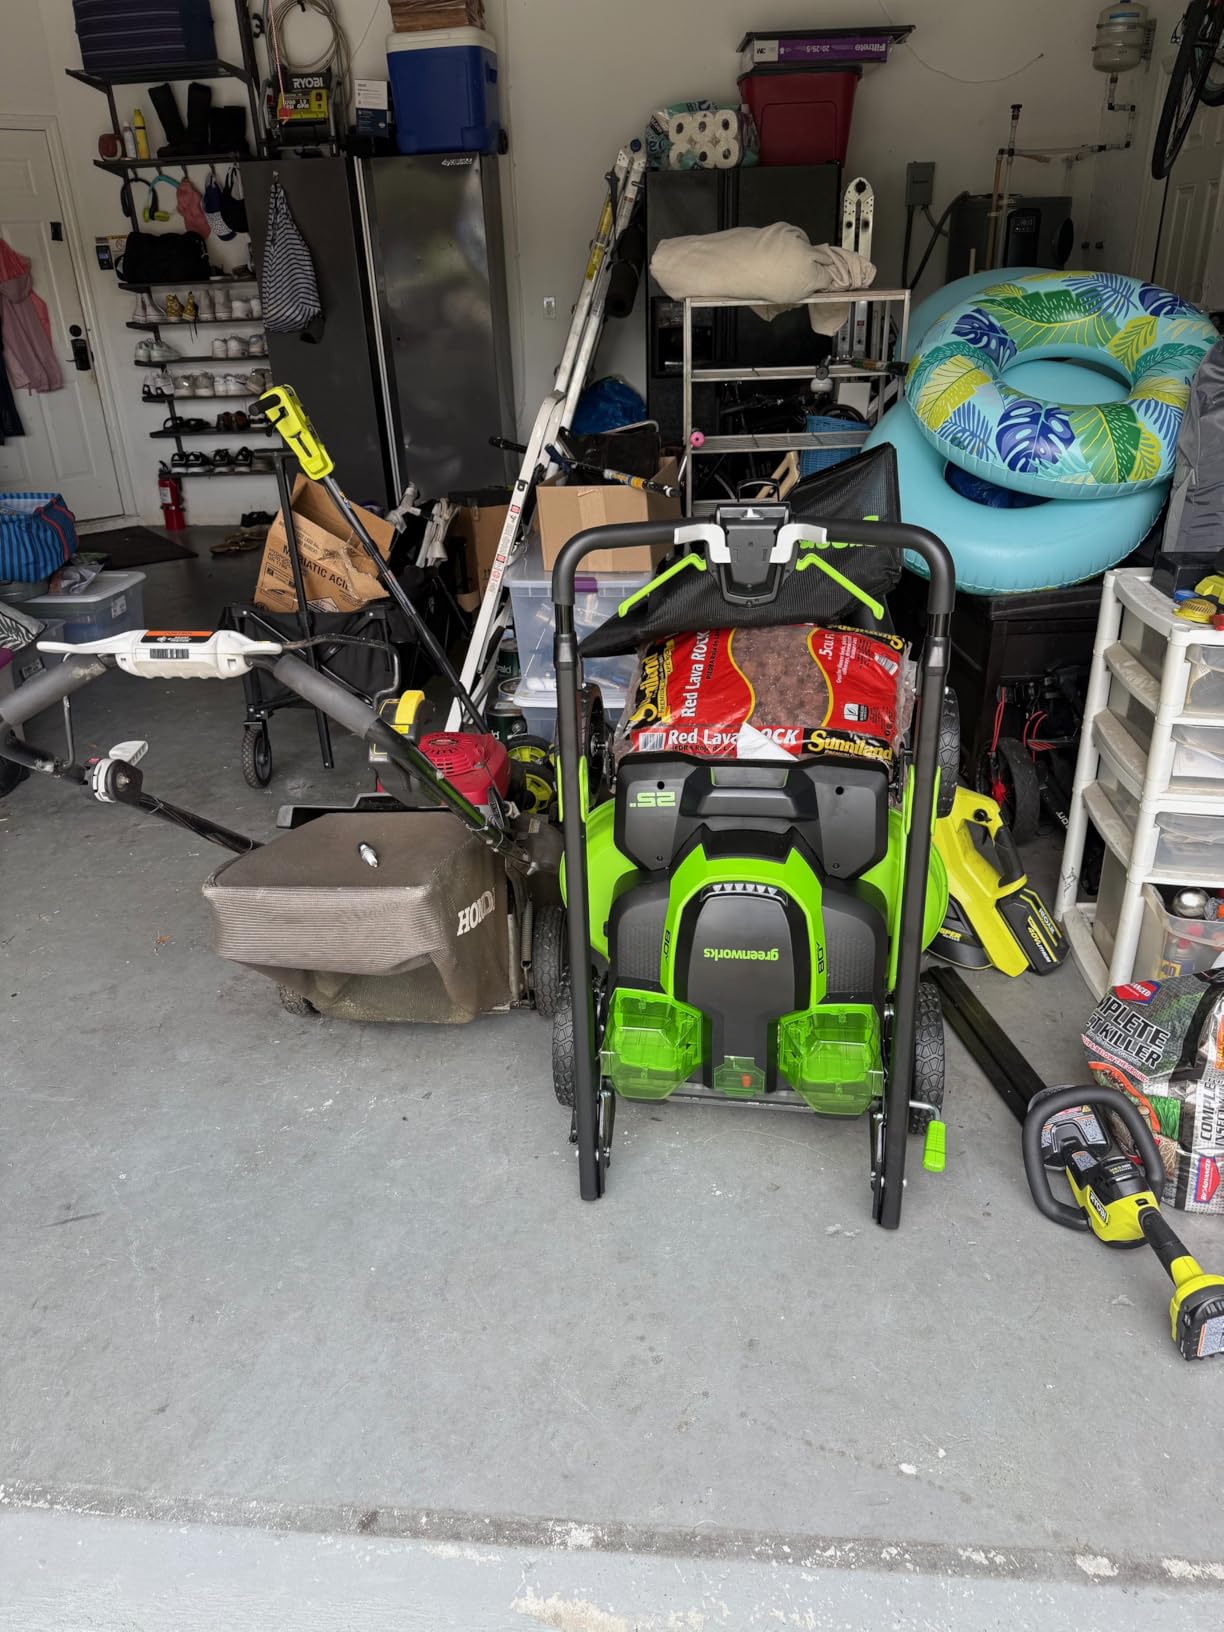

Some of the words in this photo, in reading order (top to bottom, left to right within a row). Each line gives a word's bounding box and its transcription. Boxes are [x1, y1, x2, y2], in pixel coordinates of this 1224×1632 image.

[292, 77, 324, 89] RYOBI
[685, 664, 704, 690] Lava
[681, 692, 698, 718] Red
[668, 729, 698, 745] Red
[703, 729, 738, 745] Lava
[760, 727, 800, 745] OCK
[807, 730, 893, 761] Sunniland
[703, 948, 779, 962] greenworks
[1099, 1021, 1162, 1070] KILLER
[1090, 1191, 1108, 1221] RYOBI
